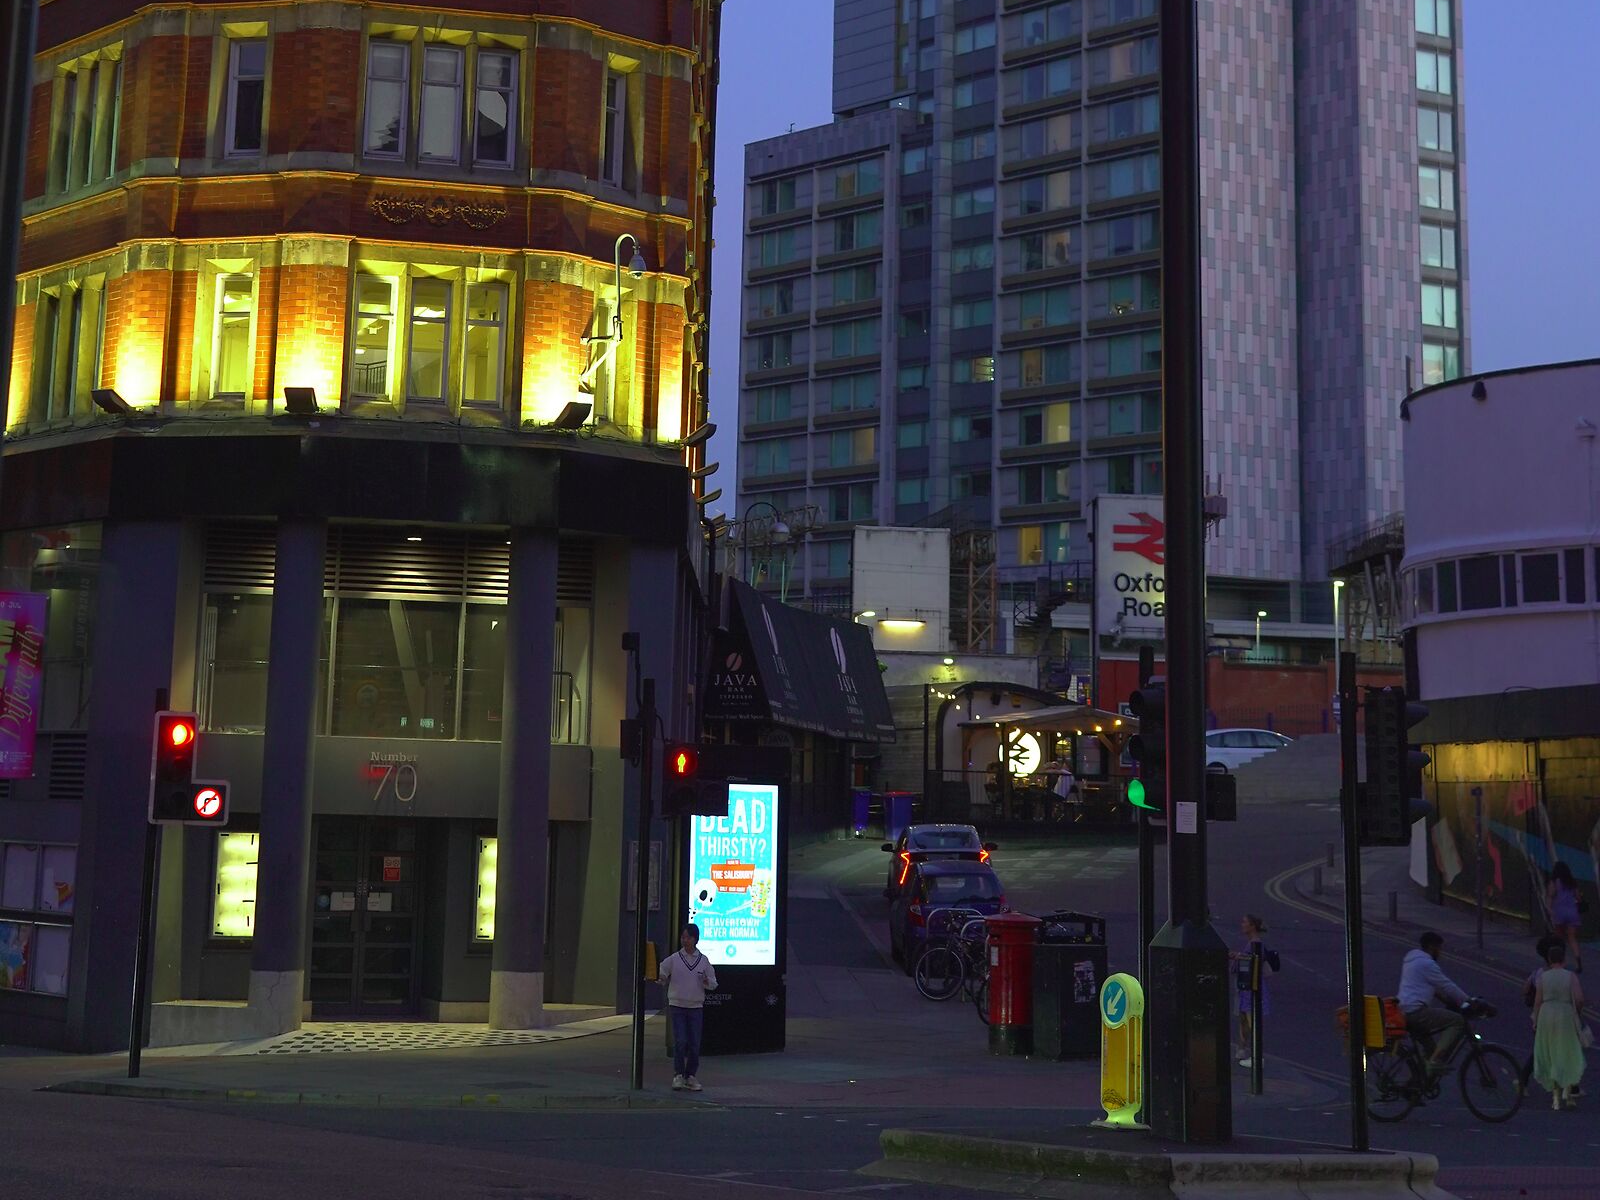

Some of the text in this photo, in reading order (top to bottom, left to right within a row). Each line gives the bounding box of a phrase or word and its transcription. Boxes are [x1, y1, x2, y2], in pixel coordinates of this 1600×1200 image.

[1114, 573, 1164, 593] Oxfo
[1123, 597, 1164, 617] Roa
[714, 674, 757, 686] JAVA
[370, 751, 418, 762] Number
[371, 764, 418, 802] 70
[699, 836, 767, 857] THIRSTY?
[712, 870, 754, 881] THE SALISBURY
[703, 917, 761, 928] BEAVERTOWN
[704, 927, 759, 939] NEVER NORMAL
